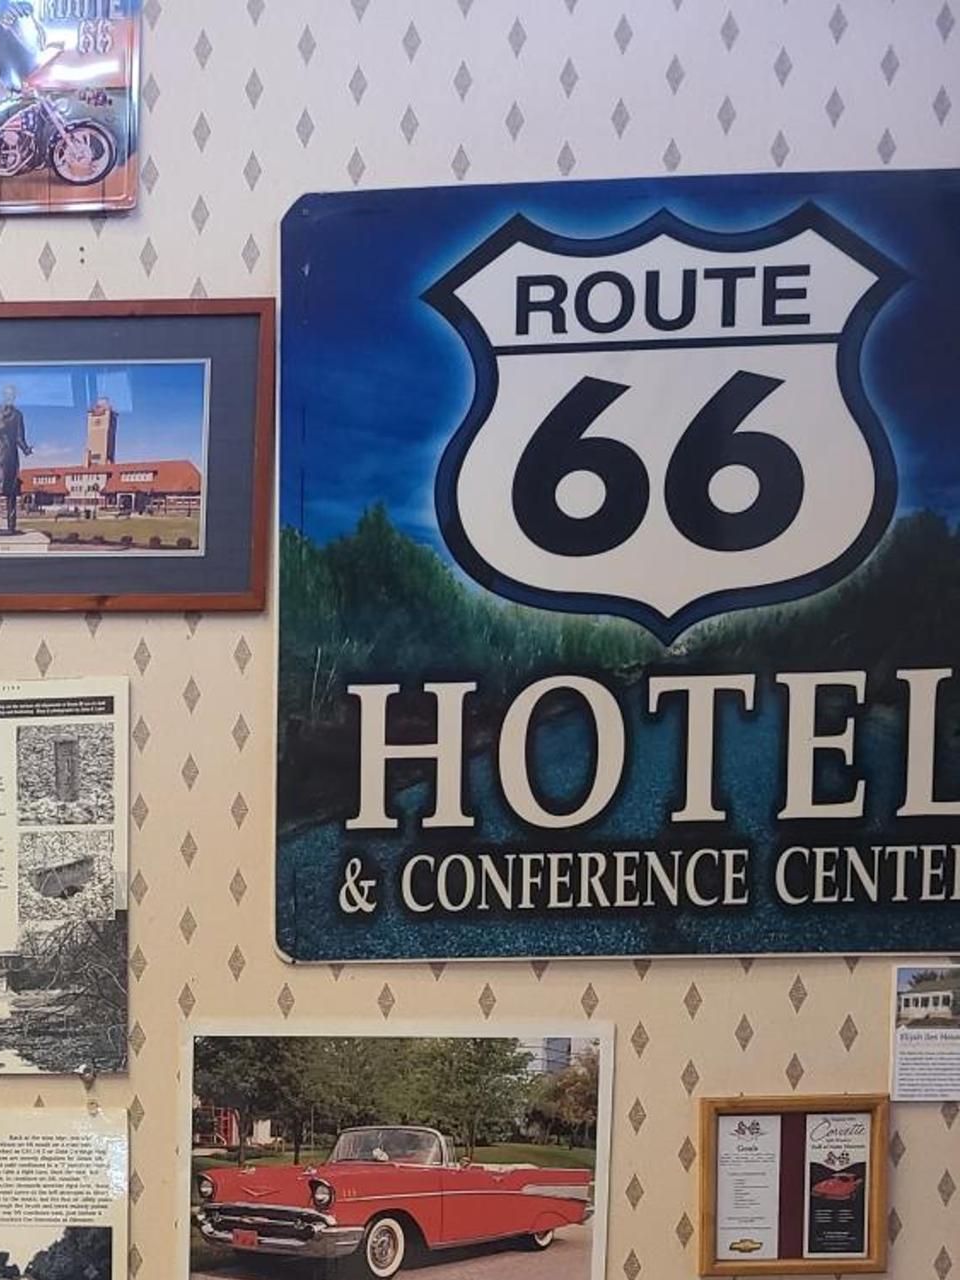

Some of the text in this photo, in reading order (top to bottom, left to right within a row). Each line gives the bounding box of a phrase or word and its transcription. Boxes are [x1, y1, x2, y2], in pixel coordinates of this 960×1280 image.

[515, 264, 811, 336] ROUTE
[512, 370, 805, 558] 66
[346, 668, 960, 831] HOTEL
[338, 858, 377, 914] &
[401, 848, 749, 913] CONFERENCE
